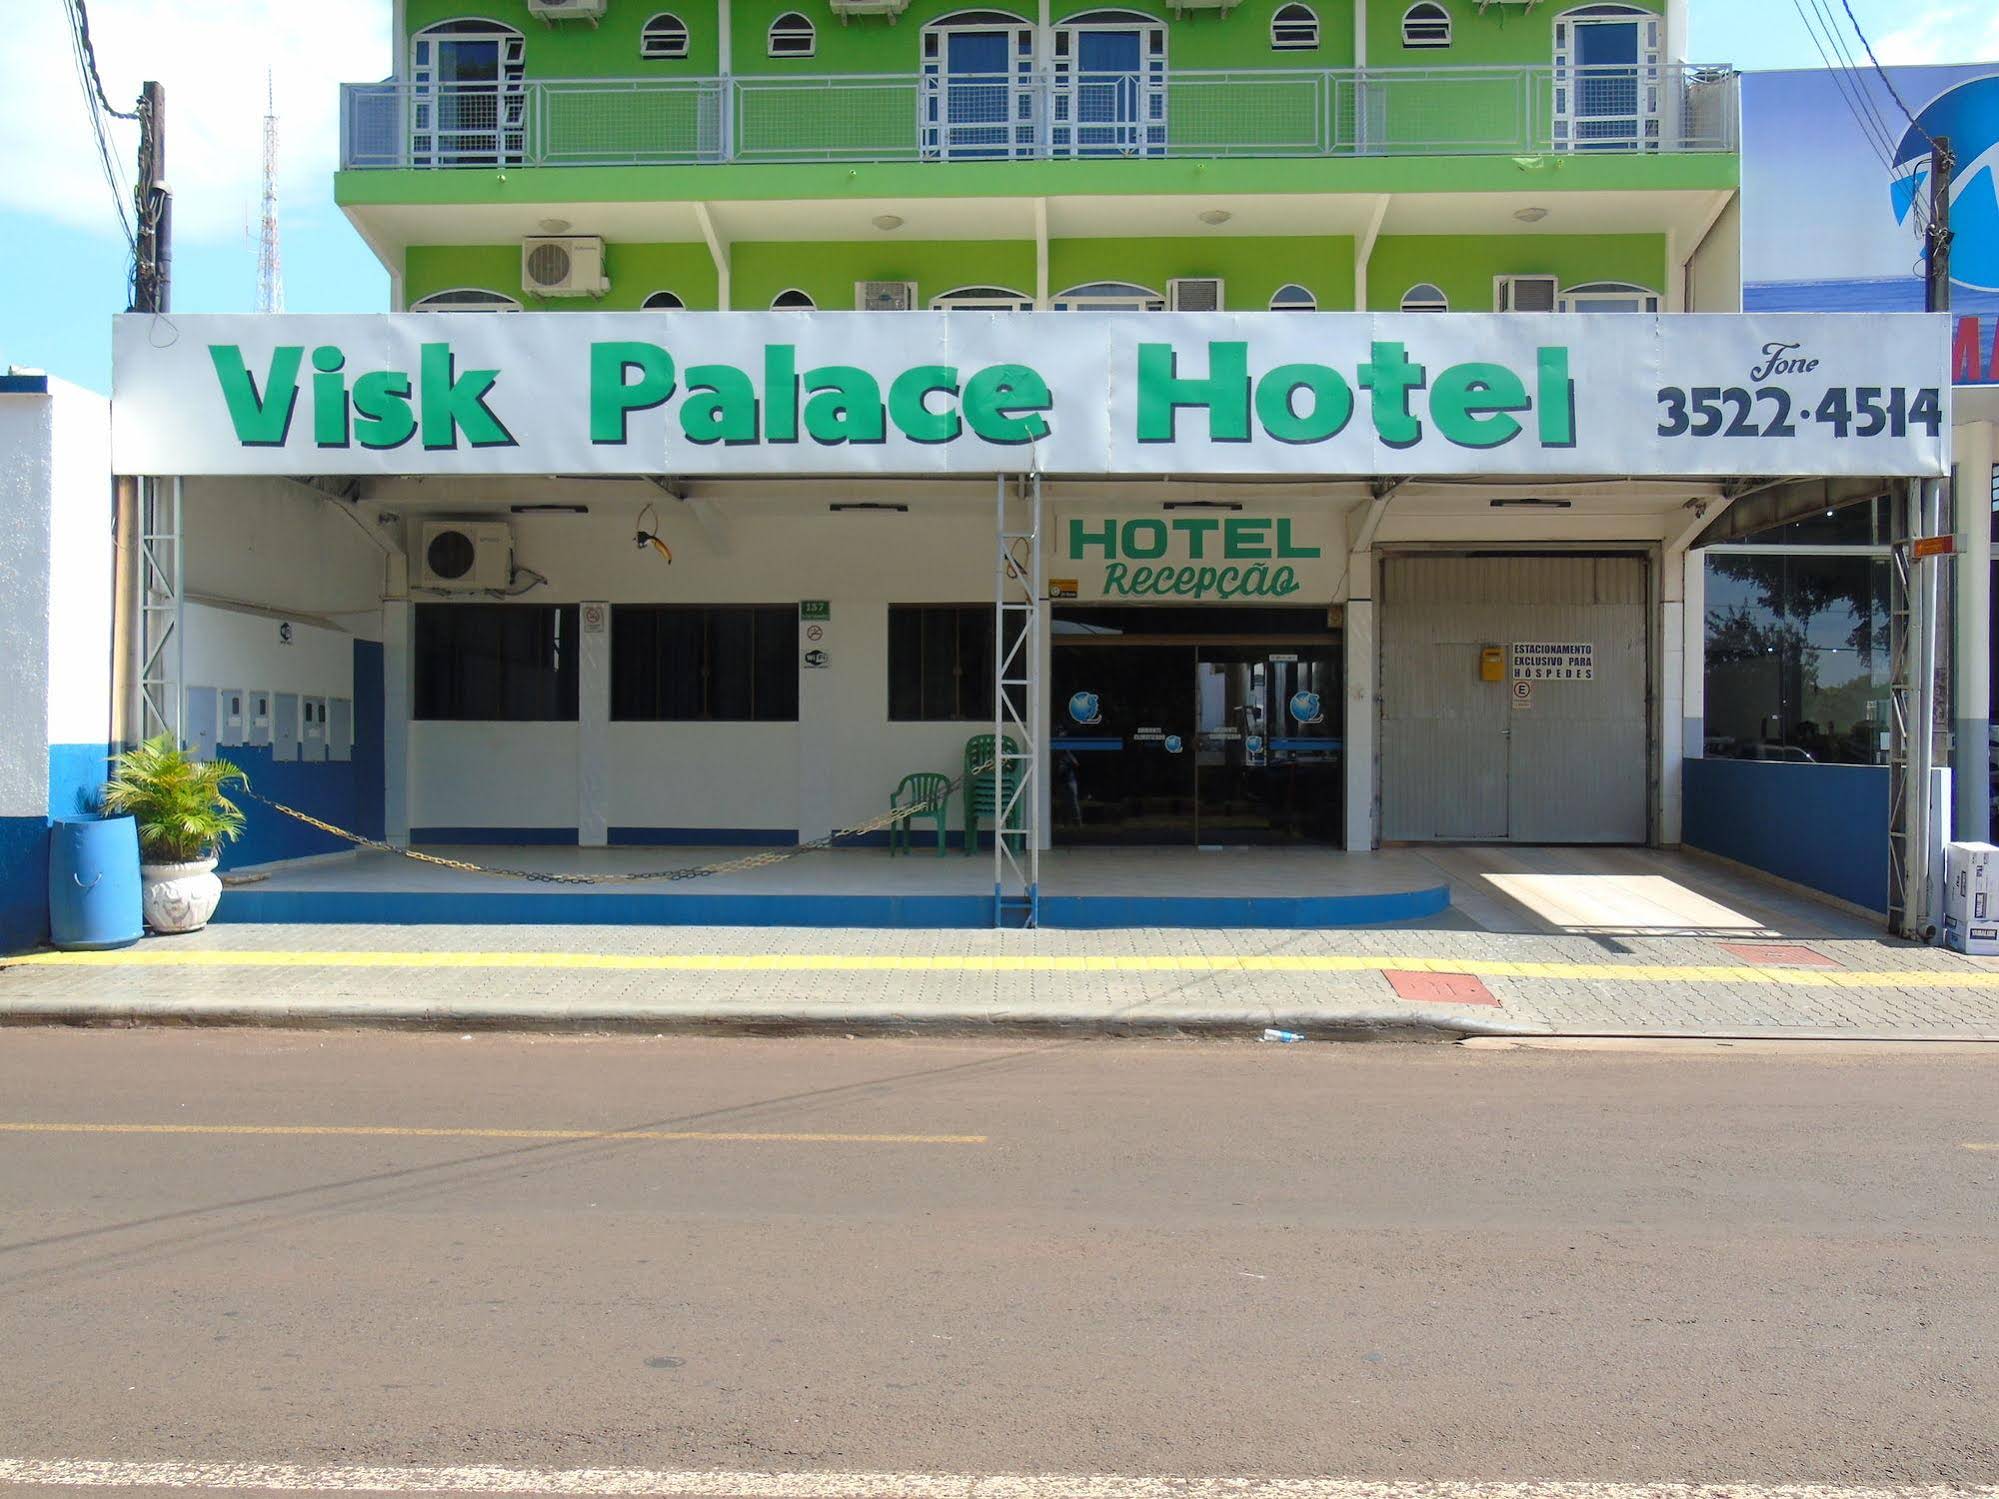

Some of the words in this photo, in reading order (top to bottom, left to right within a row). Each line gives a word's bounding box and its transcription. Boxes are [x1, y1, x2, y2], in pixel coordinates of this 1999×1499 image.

[1750, 343, 1819, 382] Fone
[209, 343, 517, 449] Visk
[590, 342, 1052, 445] Palace
[1137, 342, 1577, 448] Hotel
[1069, 519, 1321, 559] HOTEL
[1105, 561, 1300, 600] Recepção
[1514, 644, 1592, 655] ESTACIONAMENTO
[1514, 656, 1563, 666] EXCLUSIVO
[1568, 657, 1592, 667] PARA
[1518, 685, 1526, 695] E
